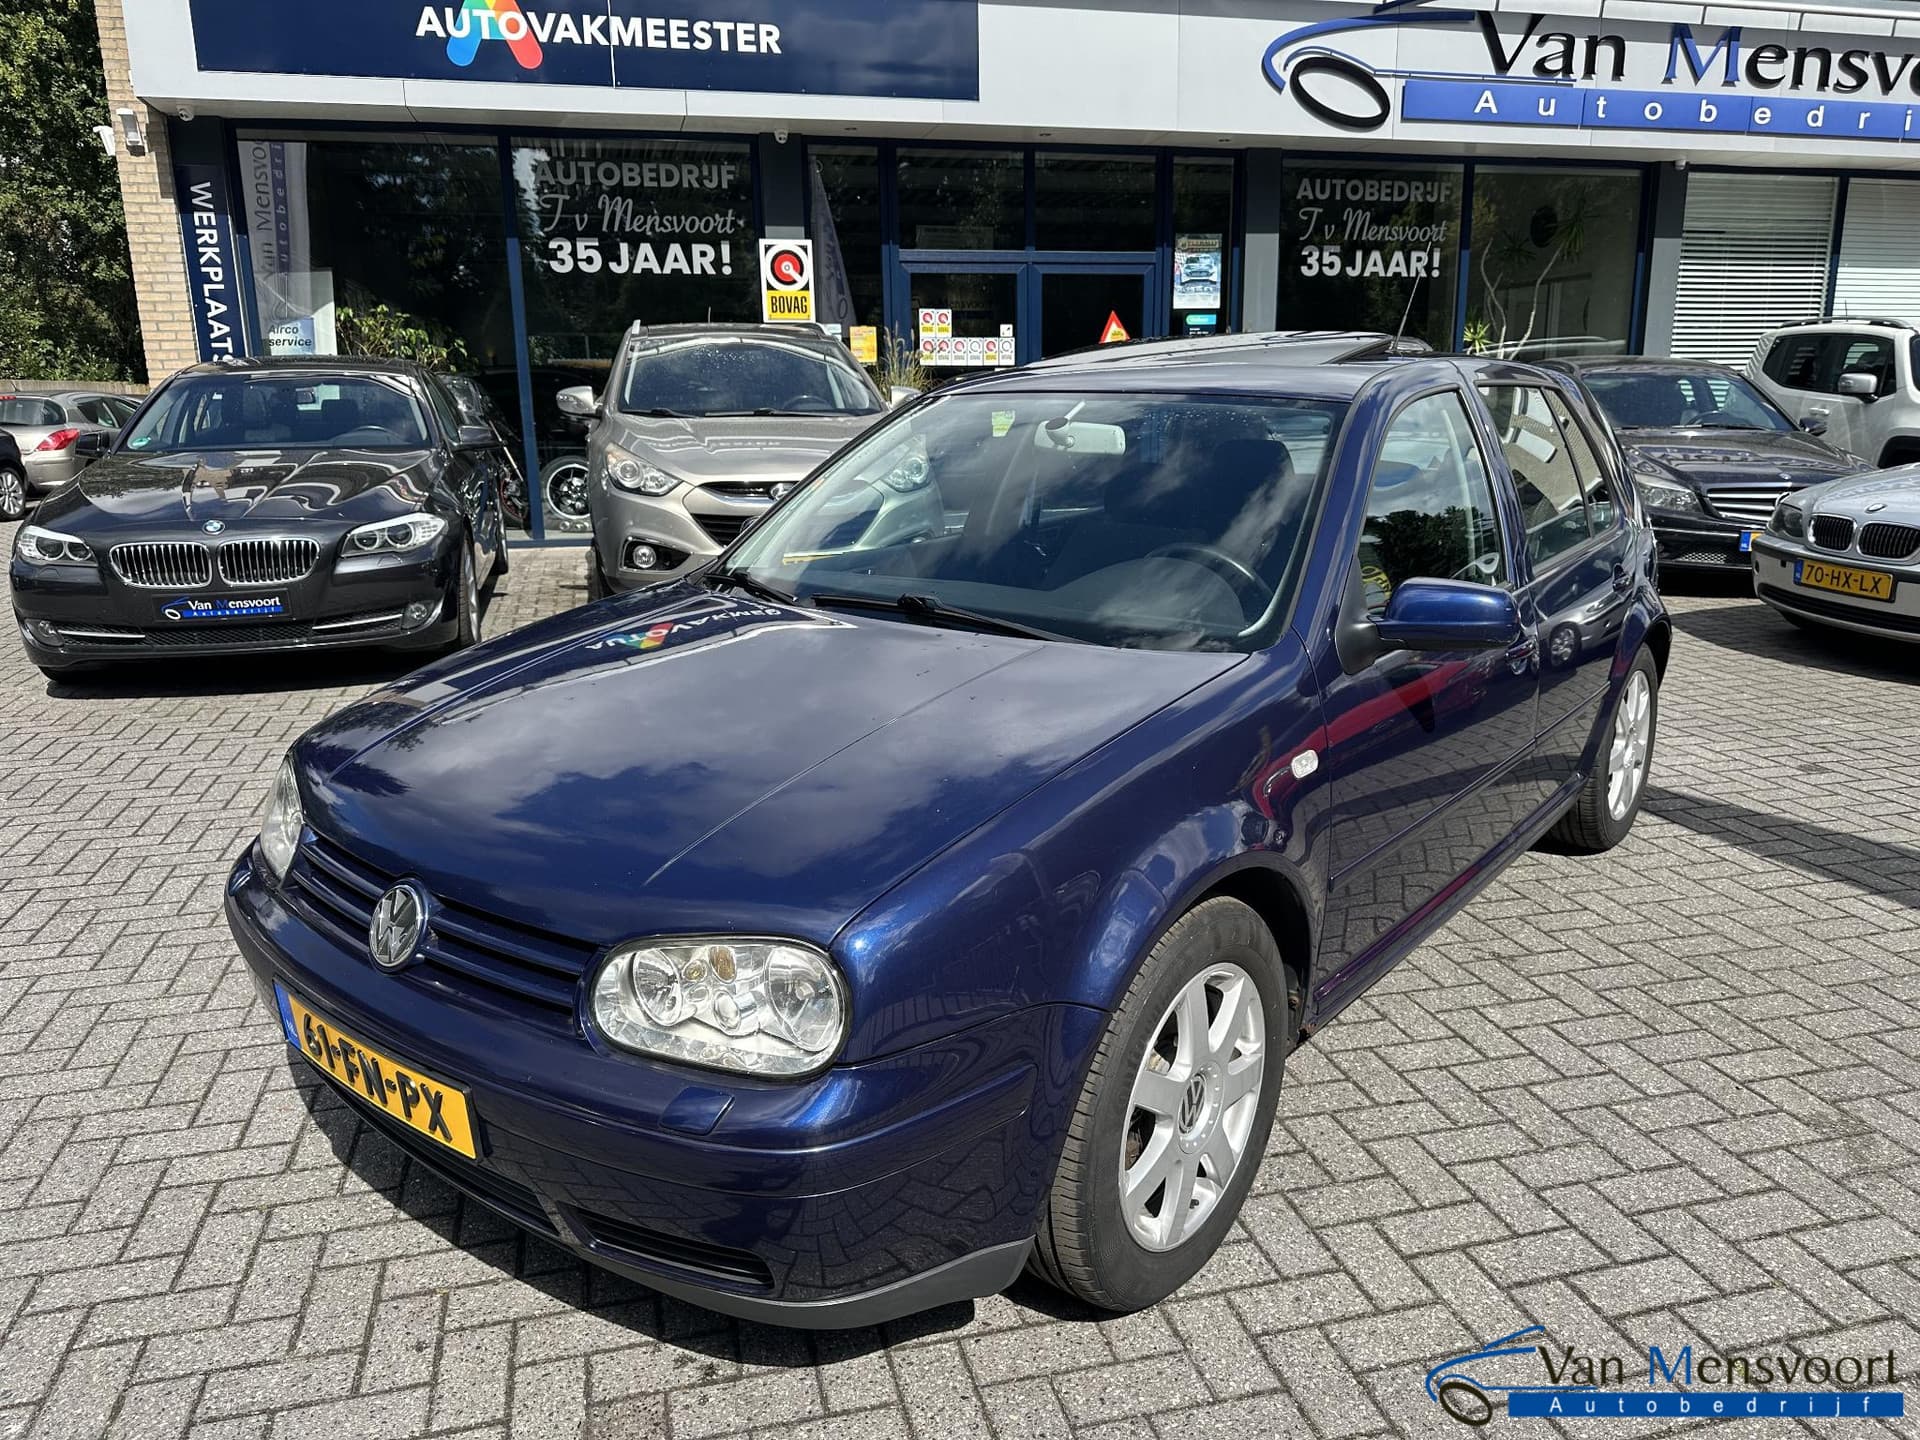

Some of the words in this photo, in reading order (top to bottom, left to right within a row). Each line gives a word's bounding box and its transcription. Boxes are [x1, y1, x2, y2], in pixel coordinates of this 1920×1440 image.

[416, 6, 782, 54] AUTOVAKMEESTER
[1477, 11, 1626, 82] Van
[1661, 23, 1920, 96] Mensv
[1474, 88, 1913, 132] Autobedri
[252, 140, 273, 232] Mensvo
[534, 160, 737, 190] AUTOBEDRIJF
[1296, 178, 1451, 203] AUTOBEDRIJF
[575, 213, 588, 232] v
[598, 194, 735, 234] Mensvoort
[1324, 224, 1335, 240] v
[1343, 208, 1448, 242] Mensvoort
[548, 237, 602, 274] 35
[608, 240, 733, 276] JAAR!
[1300, 245, 1341, 277] 35
[1345, 247, 1441, 278] JAAR!
[771, 295, 808, 314] BOVAG
[268, 337, 312, 348] service
[269, 323, 299, 335] Airco
[1804, 564, 1882, 594] 70-HX-LX
[188, 600, 212, 611] Van
[215, 596, 281, 610] Mensvoort
[304, 1013, 453, 1143] 61-FN-PX
